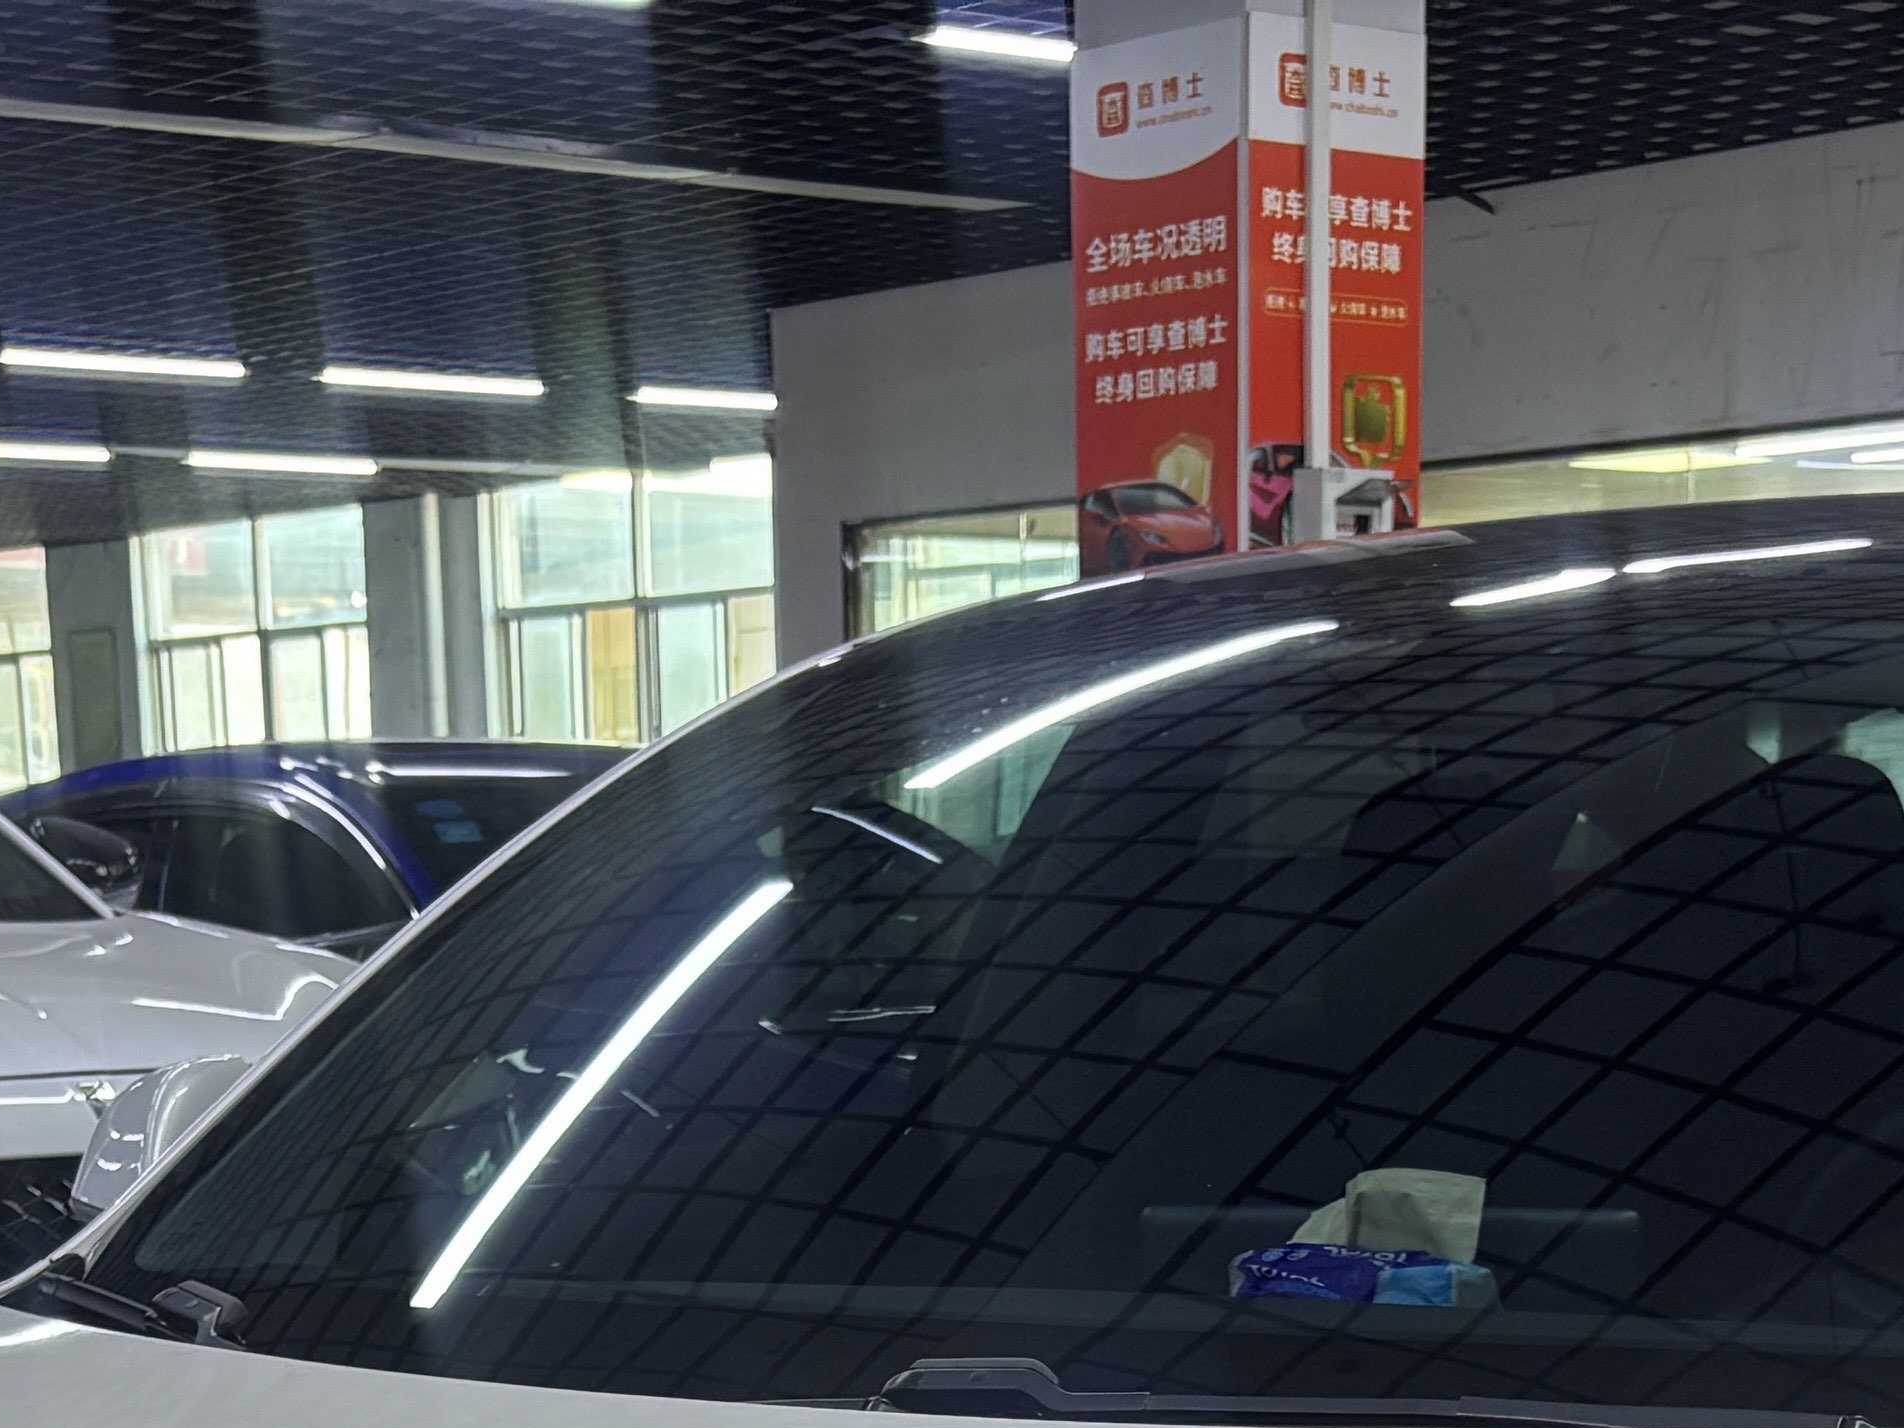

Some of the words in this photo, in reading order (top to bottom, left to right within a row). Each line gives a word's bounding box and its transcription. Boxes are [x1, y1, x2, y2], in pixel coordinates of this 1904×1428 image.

[1261, 186, 1413, 232] 购车享查博士
[1085, 214, 1227, 273] 全场车况透明
[1085, 313, 1228, 363] 购车可享查博士
[1095, 360, 1218, 404] 终身回购保障
